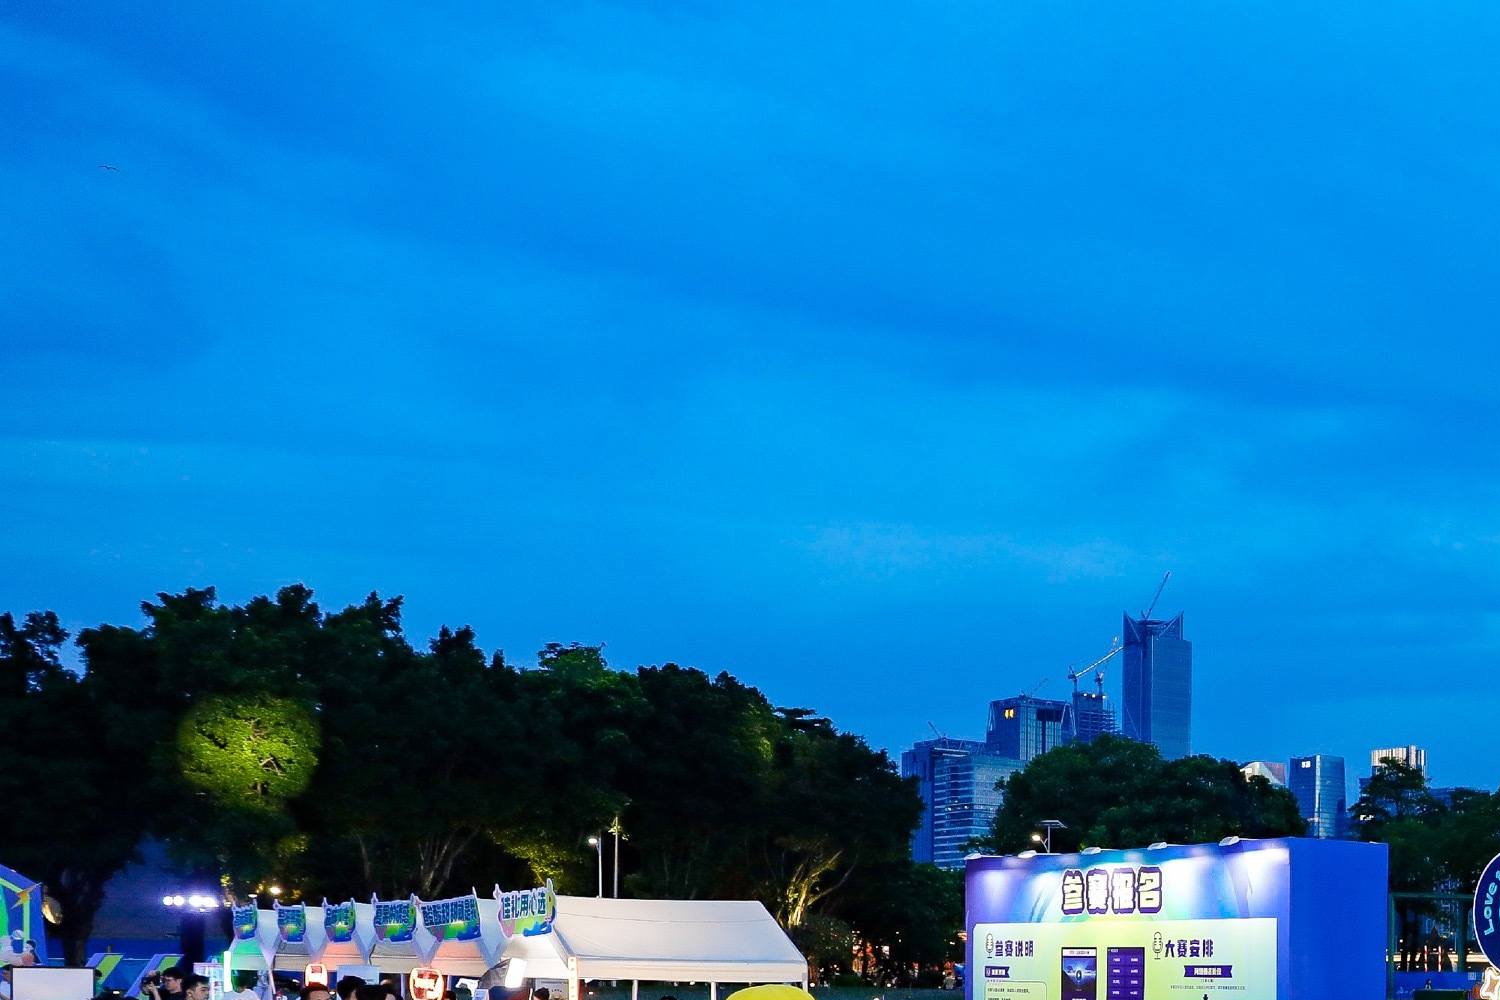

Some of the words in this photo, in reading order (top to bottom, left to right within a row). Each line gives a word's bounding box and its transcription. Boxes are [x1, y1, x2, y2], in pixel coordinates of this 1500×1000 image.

[1061, 867, 1163, 915] 参赛报名
[1484, 882, 1498, 935] Love
[995, 940, 1034, 957] 参赛说明
[1164, 939, 1214, 958] 大赛安排
